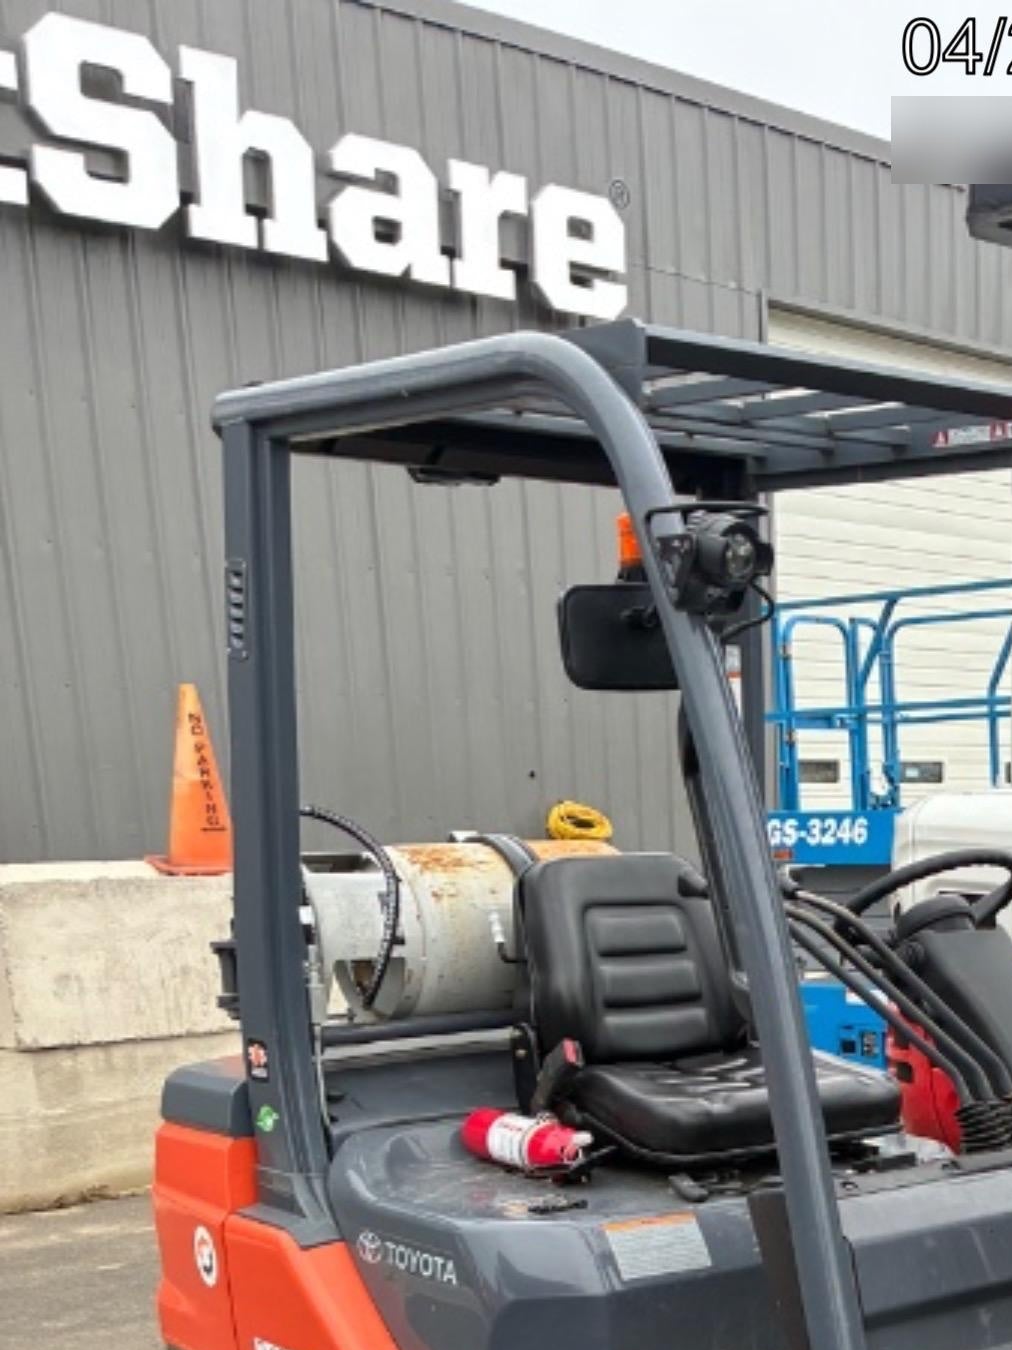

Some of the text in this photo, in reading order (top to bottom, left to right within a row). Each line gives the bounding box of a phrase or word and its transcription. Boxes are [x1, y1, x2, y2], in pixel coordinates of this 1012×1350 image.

[0, 11, 628, 320] Share
[767, 817, 869, 847] GS-3246
[385, 1241, 458, 1286] TOYOTA
